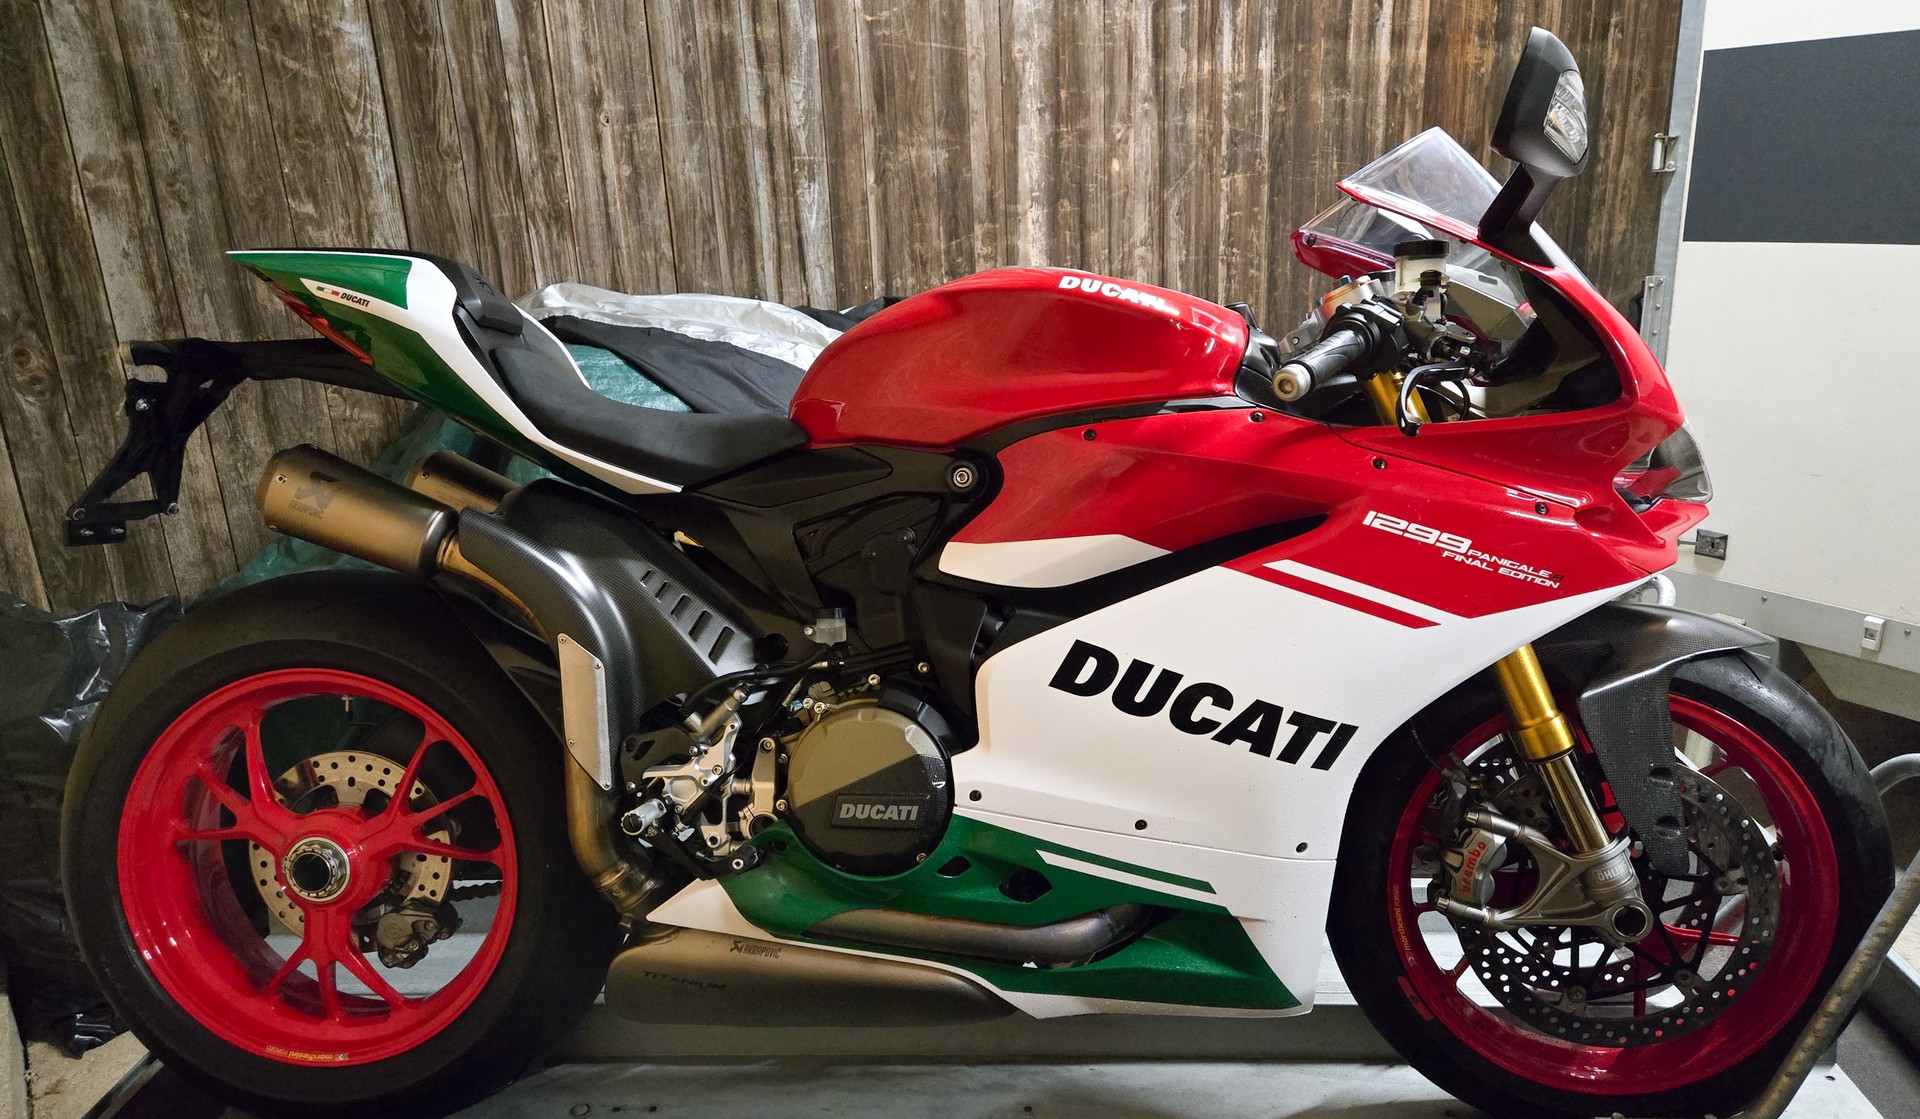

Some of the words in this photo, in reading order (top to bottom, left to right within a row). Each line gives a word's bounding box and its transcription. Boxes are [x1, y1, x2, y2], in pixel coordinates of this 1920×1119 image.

[341, 292, 370, 307] DUCATI
[1058, 276, 1179, 315] DUCATI
[1362, 510, 1472, 554] 1299
[1468, 549, 1552, 578] PANIGALE
[1442, 551, 1493, 572] FINAL
[1498, 568, 1560, 589] EDITION
[1048, 639, 1359, 771] DUCATI
[840, 803, 919, 820] DUCATI
[1459, 842, 1486, 894] brembo
